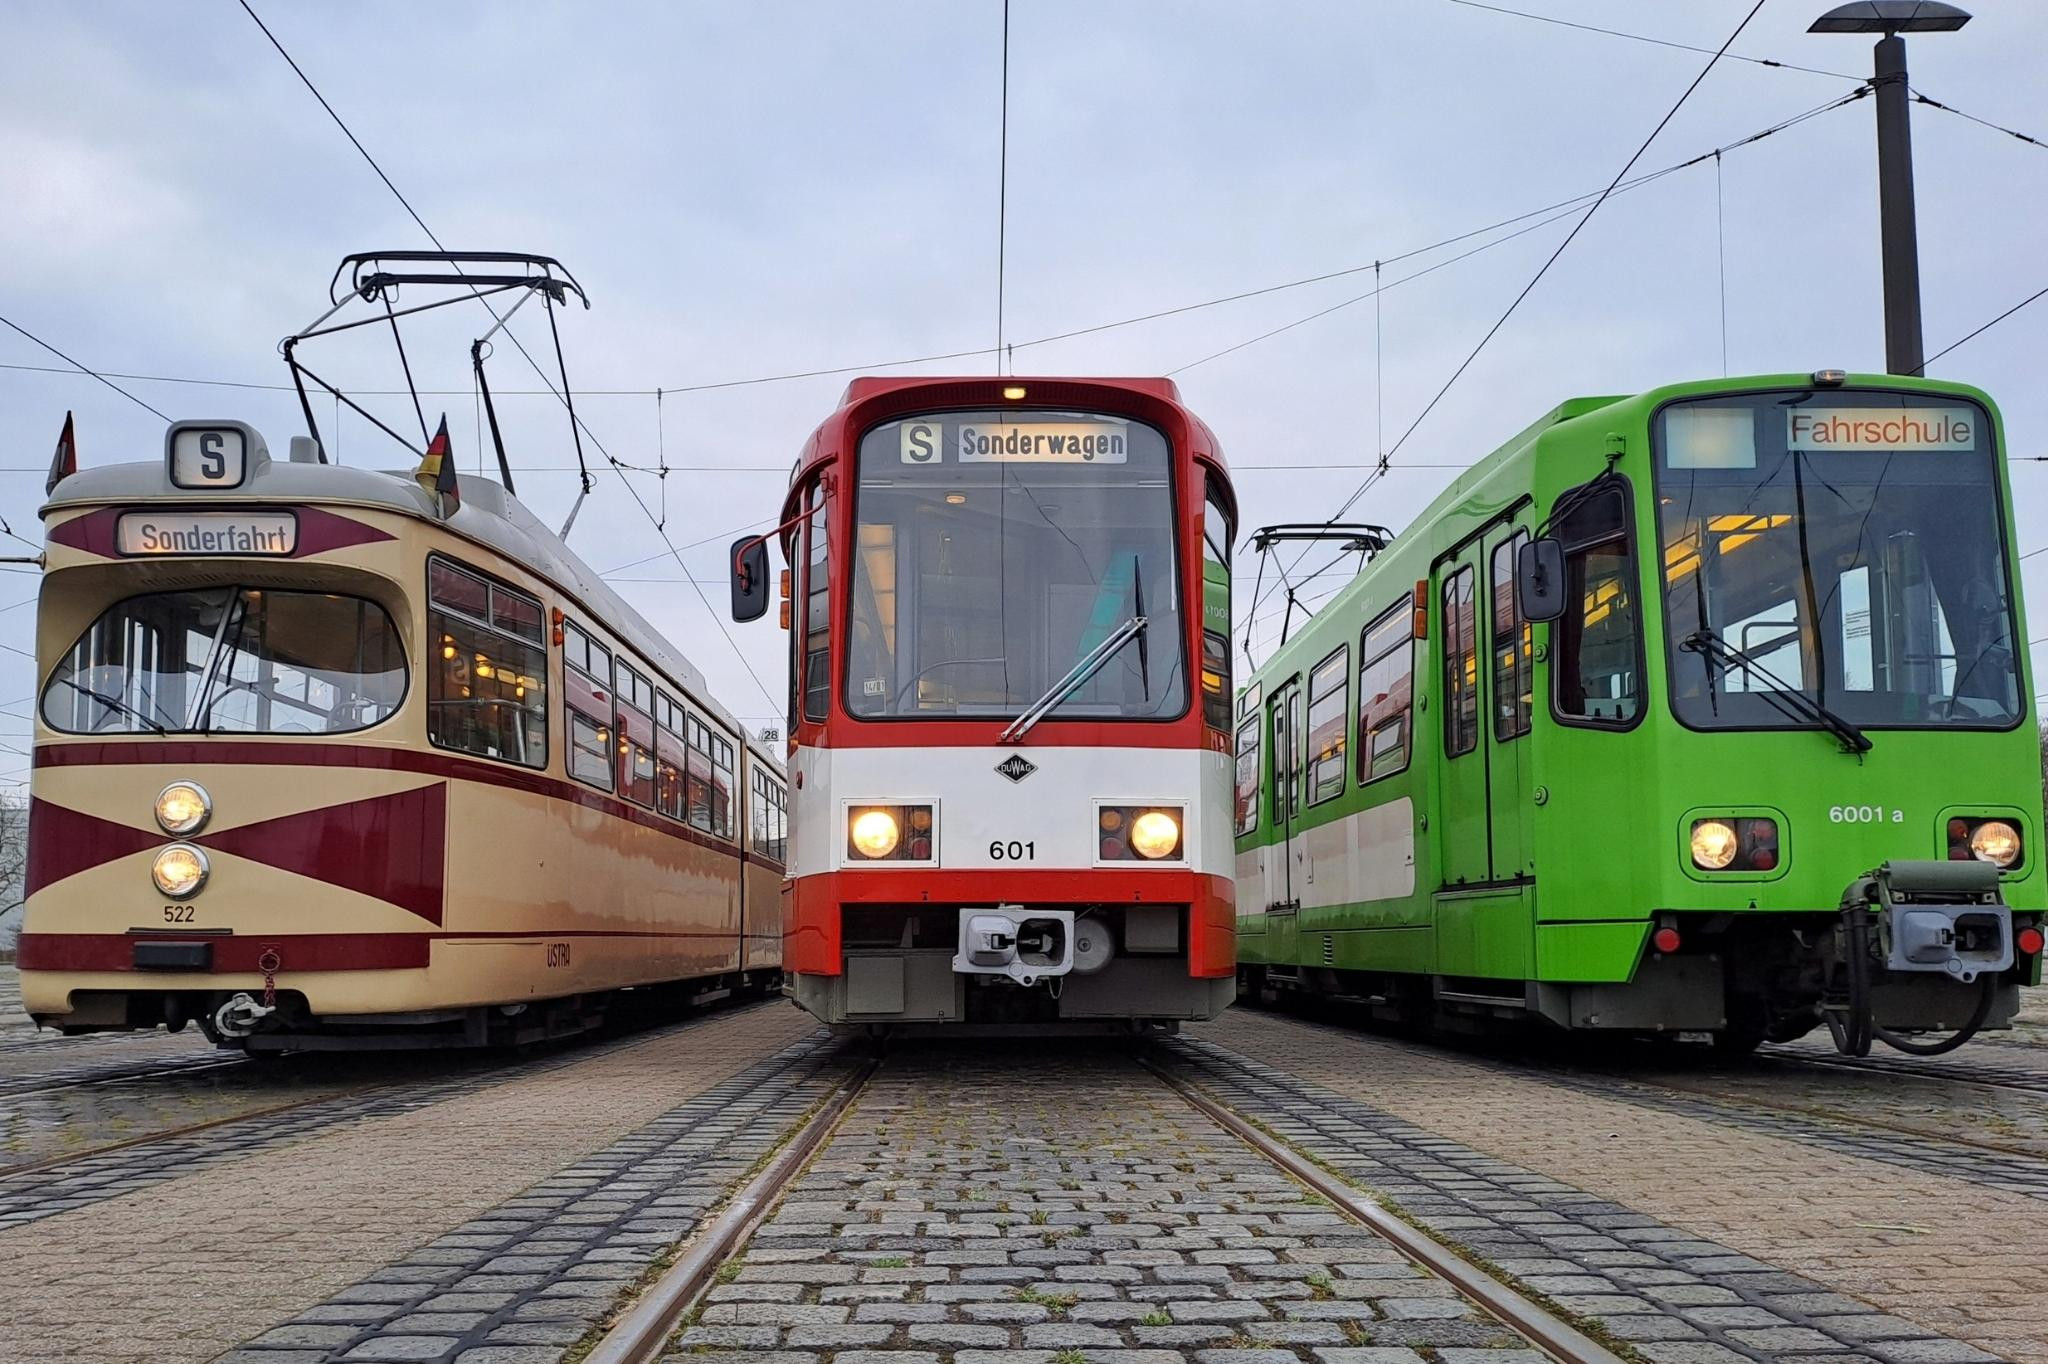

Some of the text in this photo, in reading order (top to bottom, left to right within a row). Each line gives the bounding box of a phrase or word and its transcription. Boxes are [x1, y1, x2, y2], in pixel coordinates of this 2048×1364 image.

[909, 425, 934, 463] S
[962, 427, 1124, 461] Sonderwagen
[1792, 415, 1971, 444] Fahrschule
[200, 432, 226, 480] S
[141, 523, 287, 552] Sonderfahrt
[764, 730, 778, 740] 28
[1829, 806, 1904, 823] 6001 a
[989, 840, 1035, 861] 601
[164, 905, 195, 923] 522
